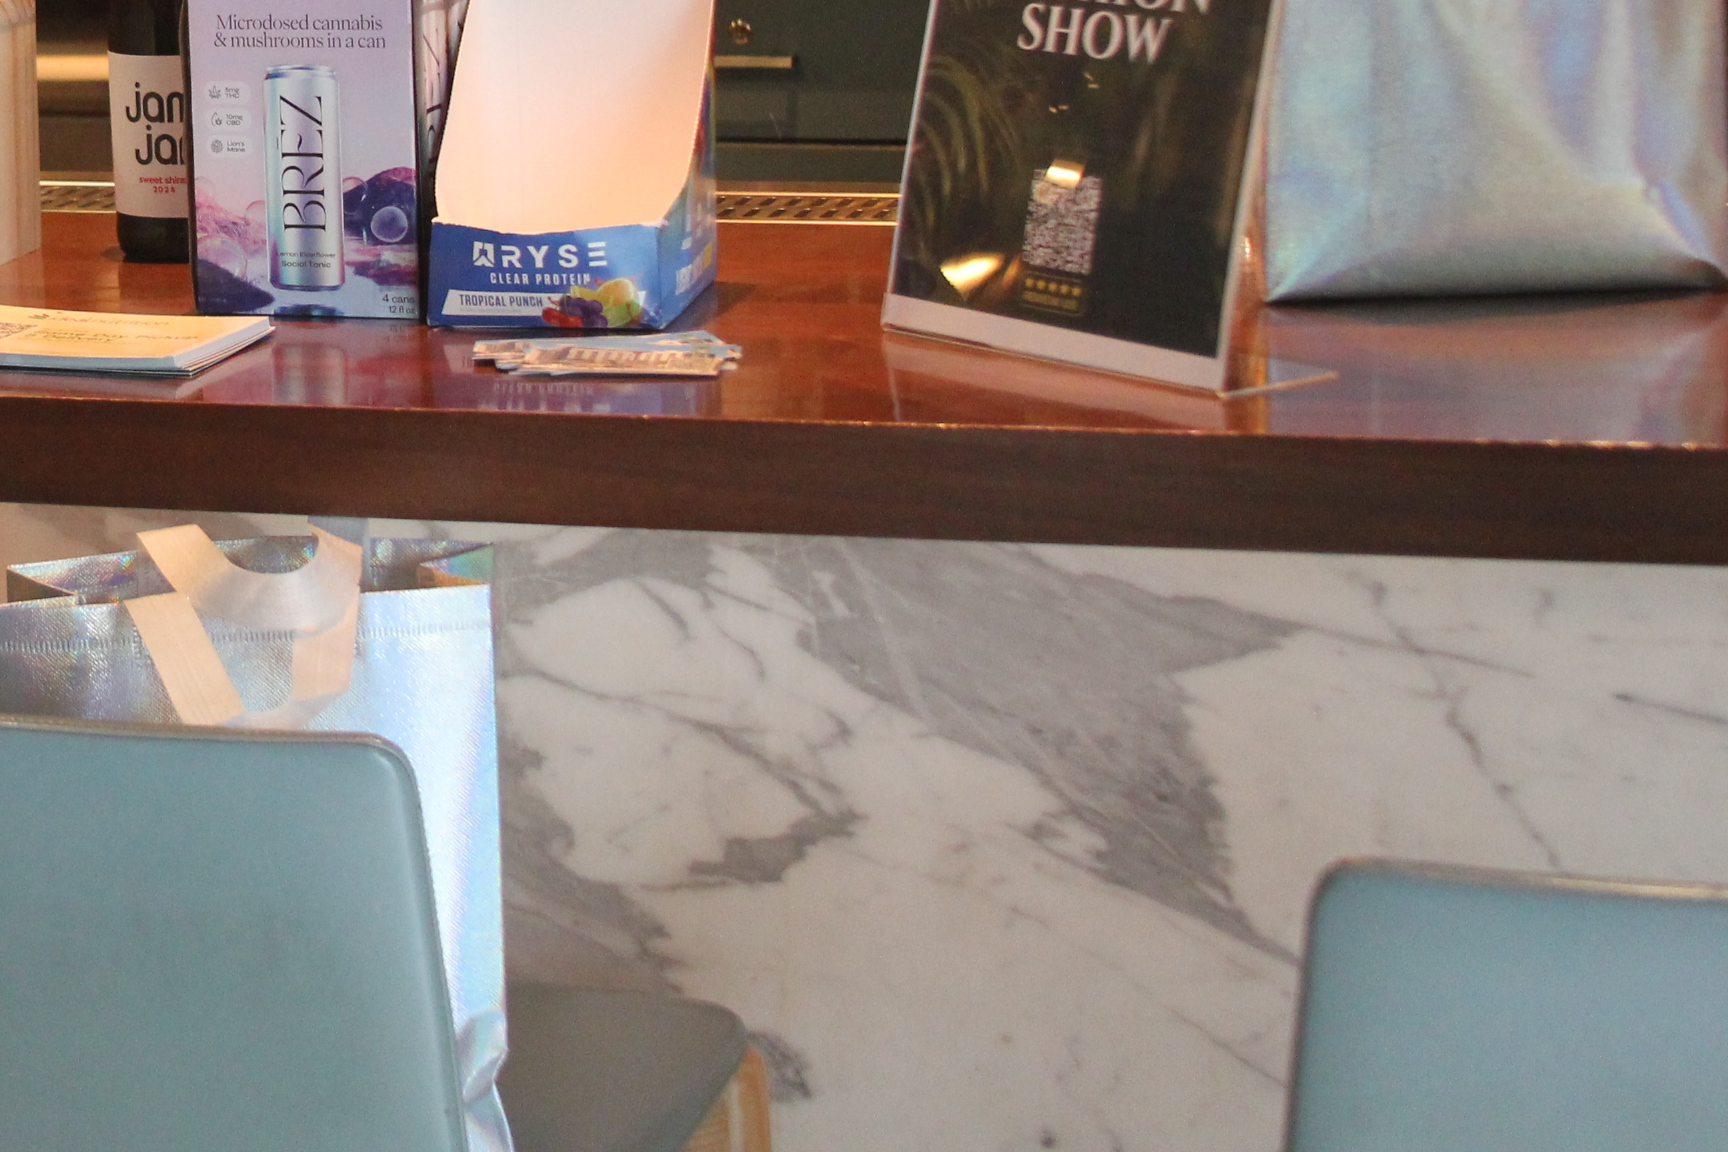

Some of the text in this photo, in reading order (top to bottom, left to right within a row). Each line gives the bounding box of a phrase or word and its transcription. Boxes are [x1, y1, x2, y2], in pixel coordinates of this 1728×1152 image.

[216, 14, 383, 31] Microdosed cannabis
[214, 32, 386, 49] & mushrooms in a can
[1016, 2, 1172, 66] SHOW
[134, 124, 185, 165] ja
[139, 176, 162, 184] sweet
[501, 241, 608, 269] RYSE
[281, 260, 331, 268] Social Tonic
[490, 272, 591, 286] CLEAR PROTEIN
[382, 293, 415, 303] 4 cans
[459, 293, 543, 308] TROPICAL PUNCH
[388, 306, 397, 314] 12
